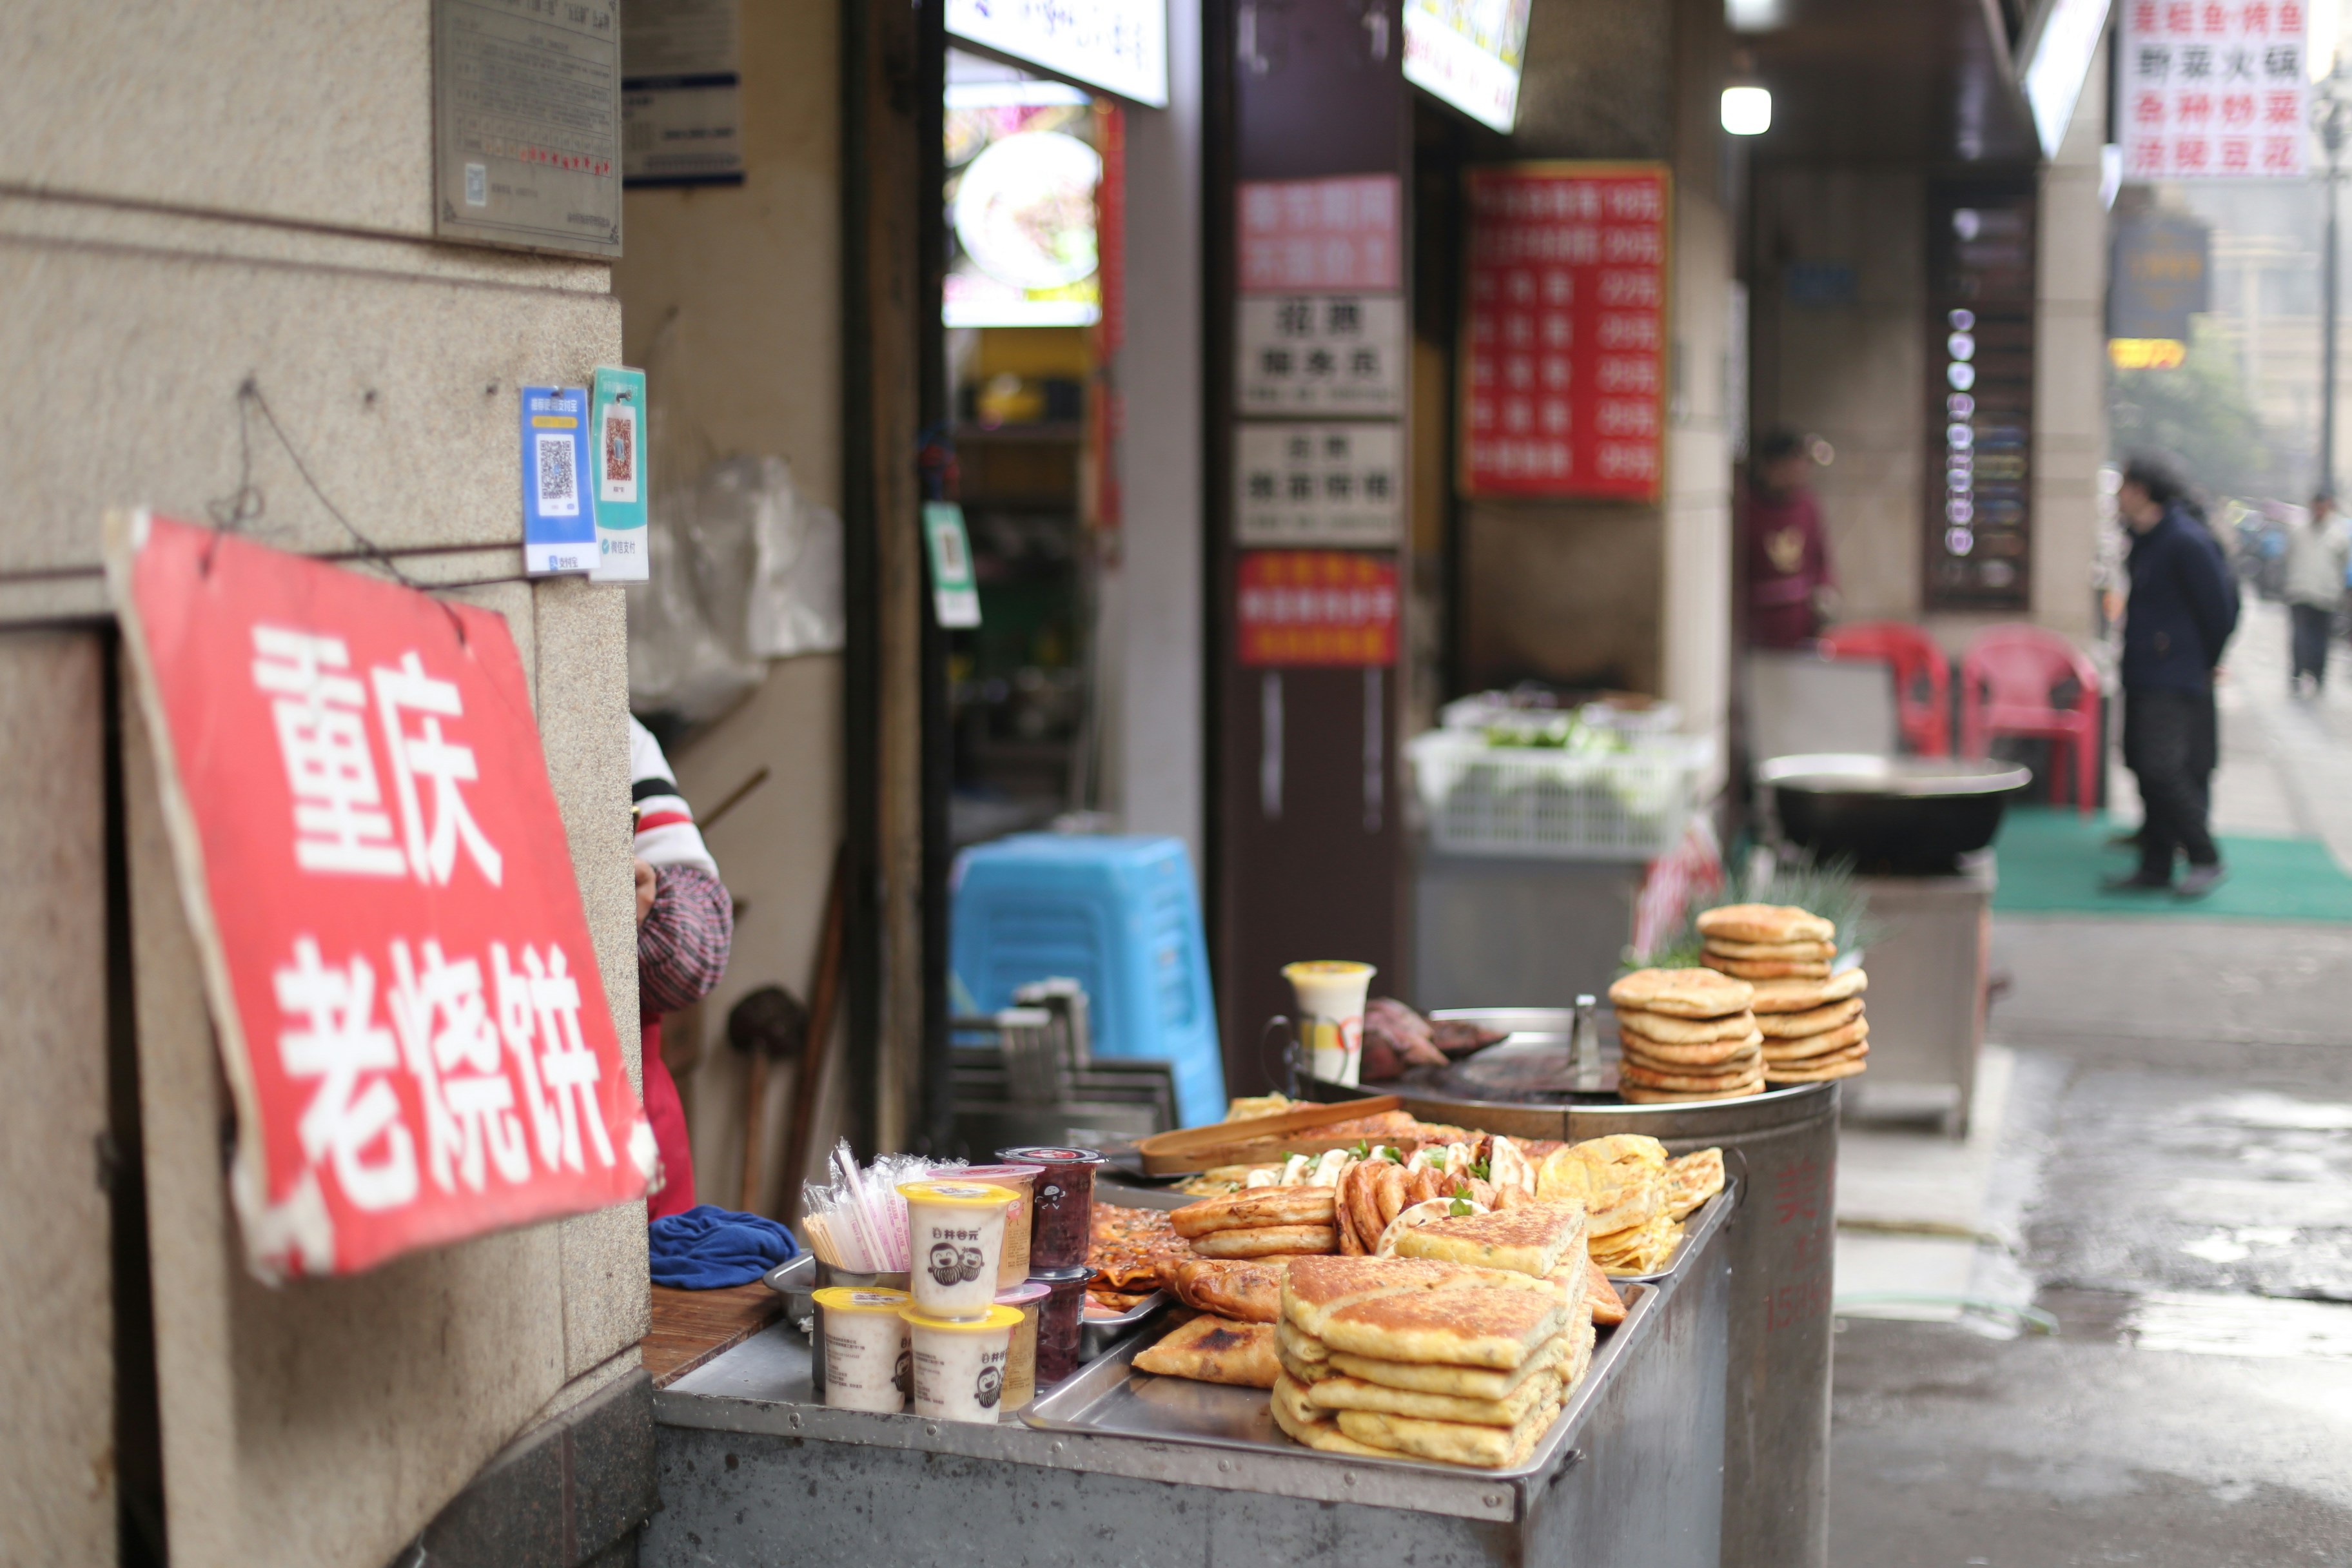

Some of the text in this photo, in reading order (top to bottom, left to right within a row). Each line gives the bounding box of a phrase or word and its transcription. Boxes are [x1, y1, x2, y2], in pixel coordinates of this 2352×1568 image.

[2136, 45, 2300, 80] 野菜火锅
[558, 556, 578, 568] 支付宝
[611, 540, 636, 555] 微信支付
[251, 624, 504, 887] 重庆
[273, 936, 616, 1212] 老烧饼
